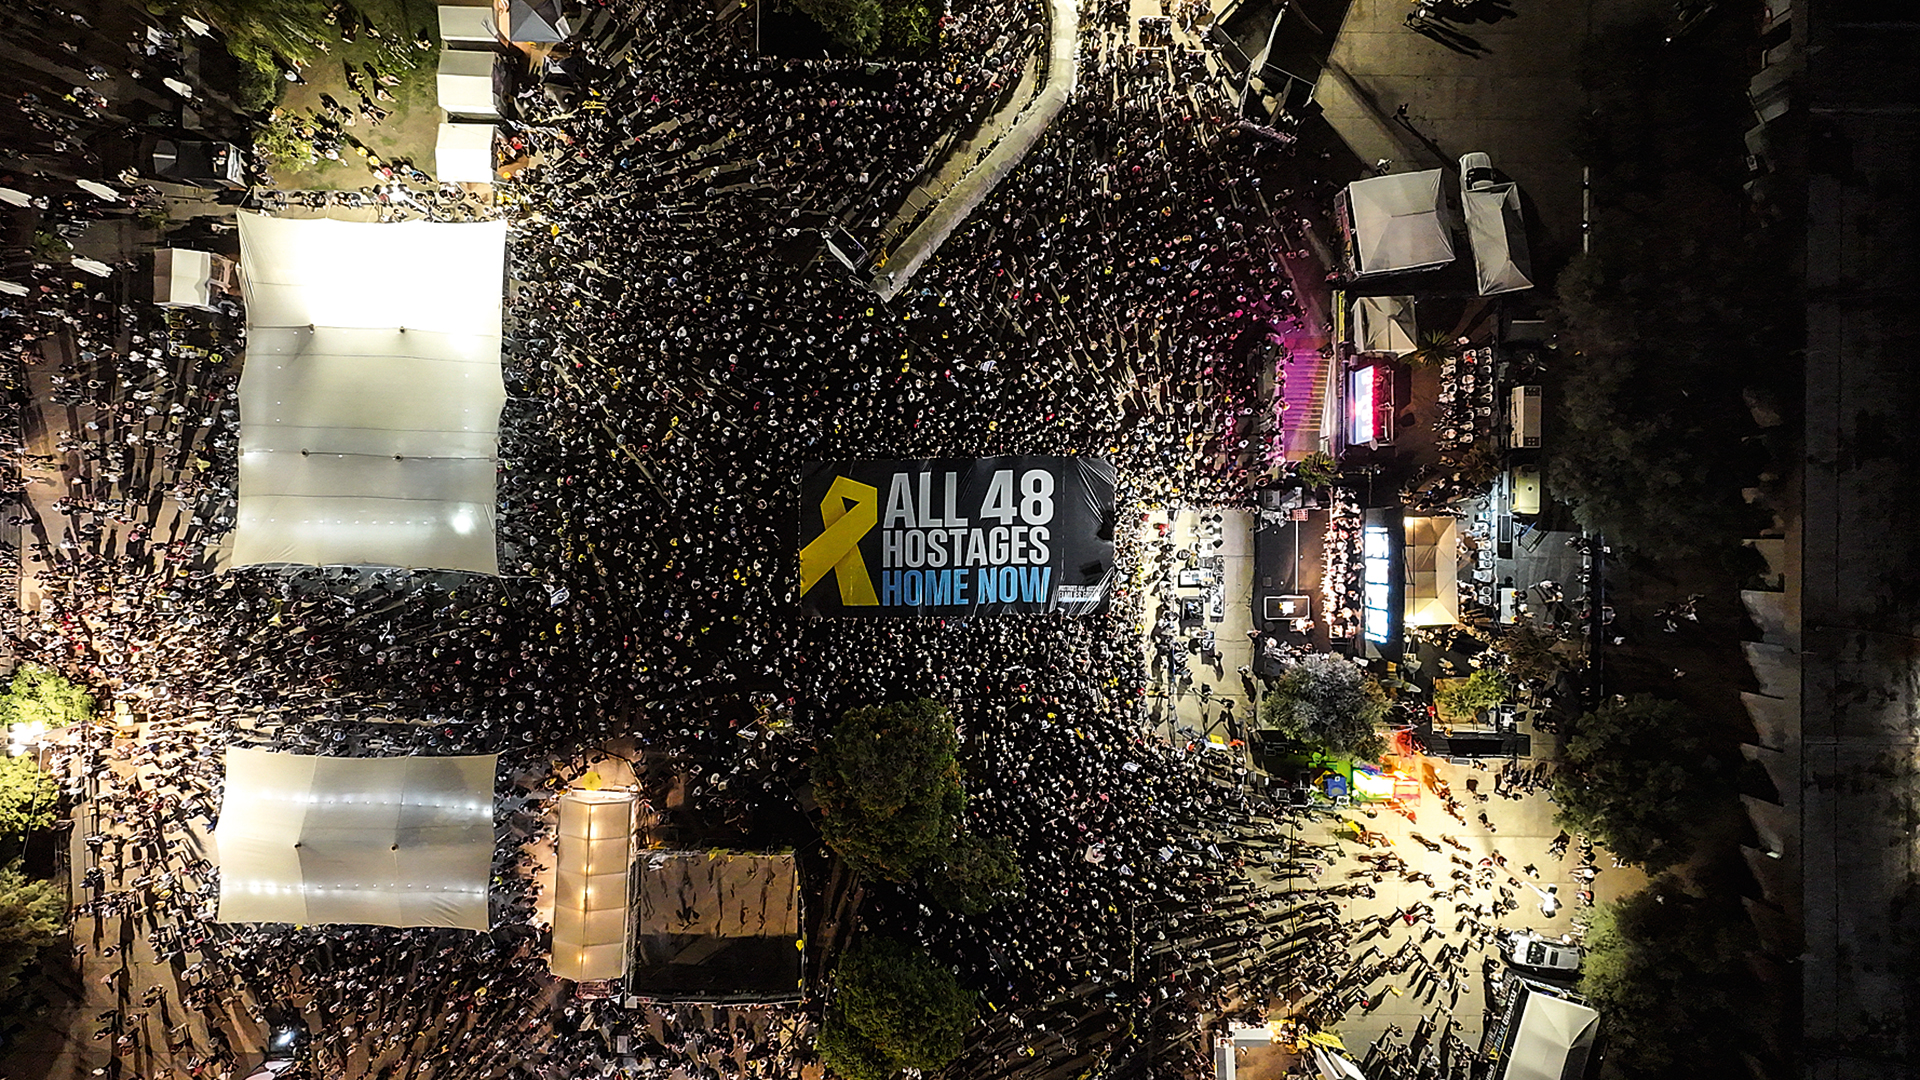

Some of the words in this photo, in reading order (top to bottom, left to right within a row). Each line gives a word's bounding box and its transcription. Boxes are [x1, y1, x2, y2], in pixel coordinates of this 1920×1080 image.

[883, 472, 968, 528] ALL
[979, 469, 1054, 525] 48
[883, 526, 1050, 568] HOSTAGES
[882, 568, 968, 606] HOME
[977, 566, 1051, 605] NOW
